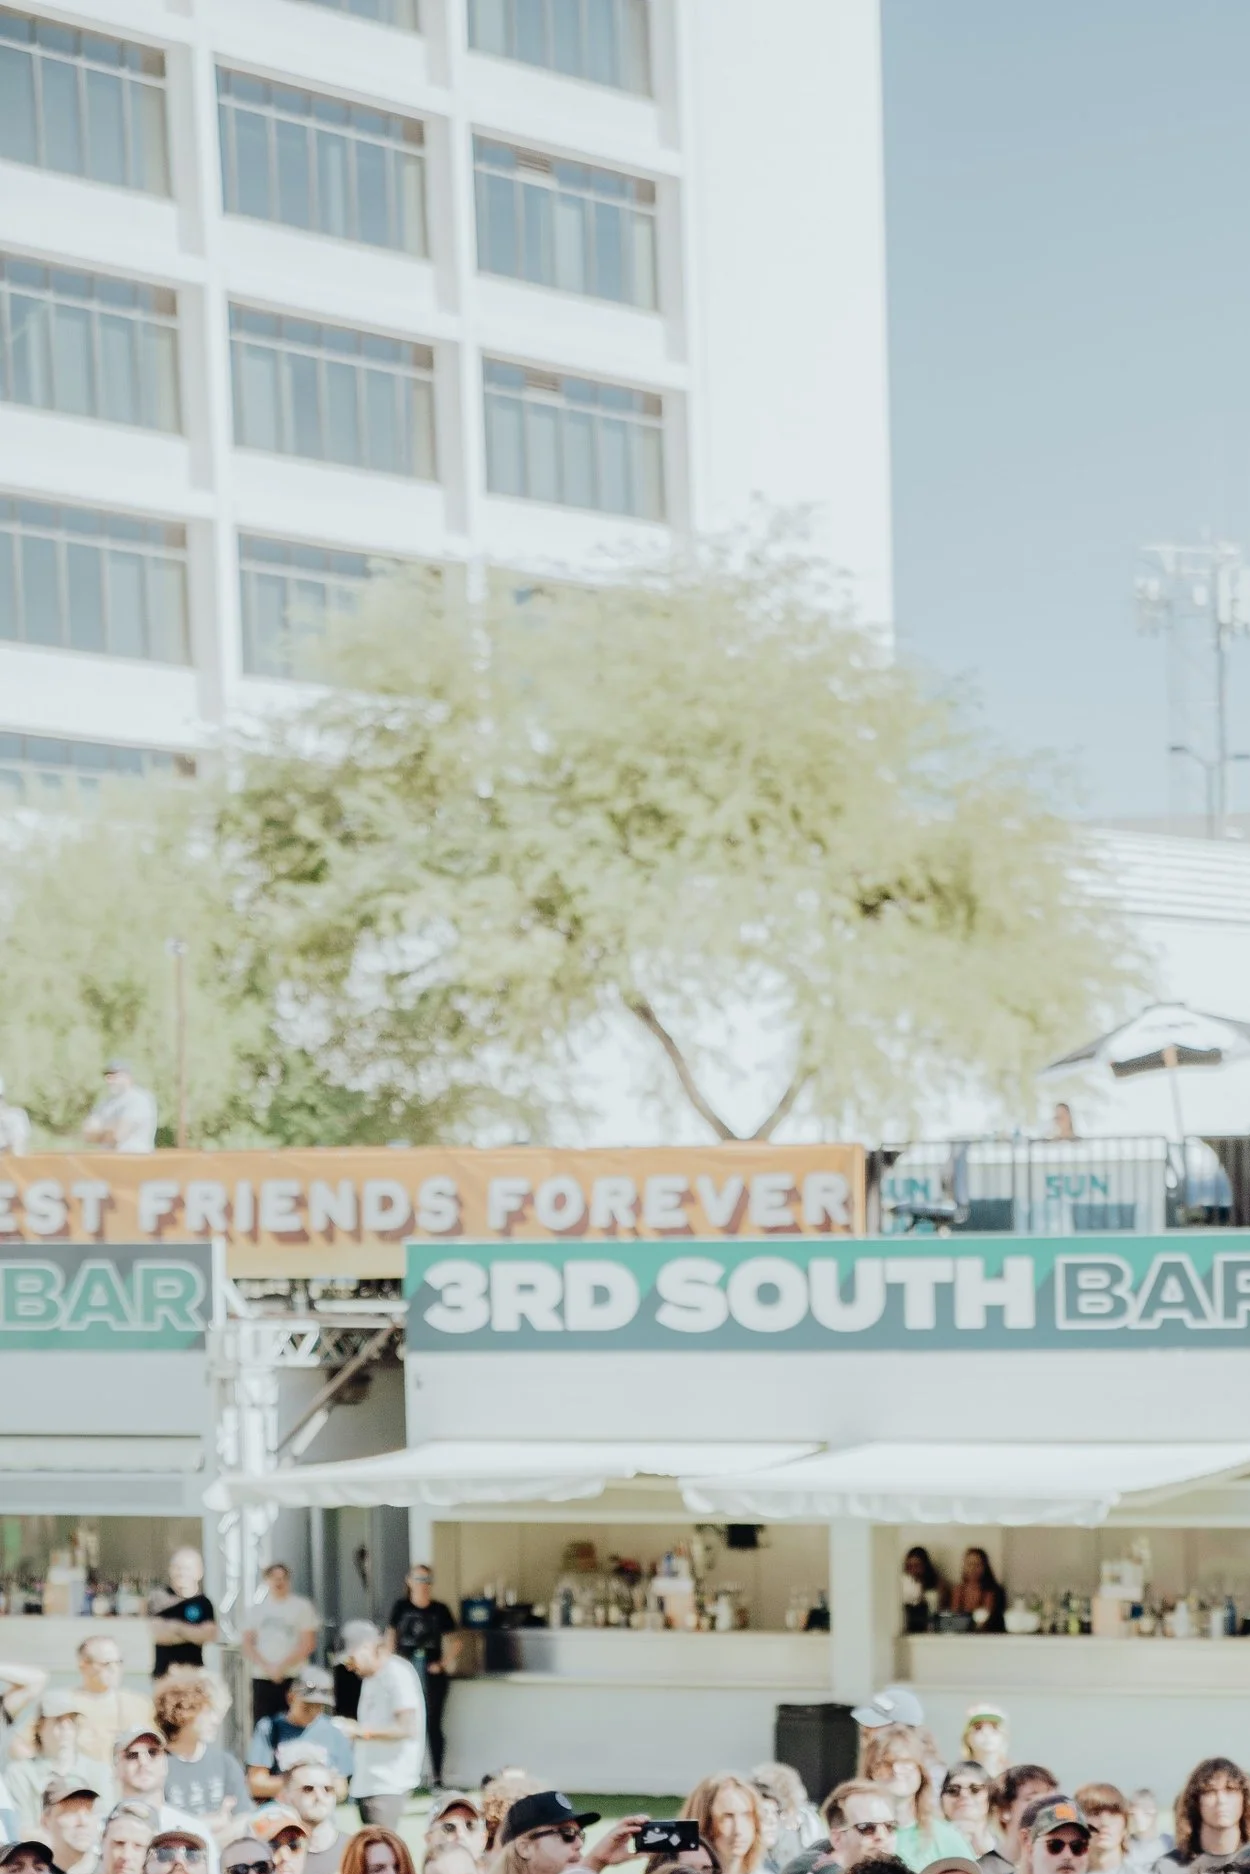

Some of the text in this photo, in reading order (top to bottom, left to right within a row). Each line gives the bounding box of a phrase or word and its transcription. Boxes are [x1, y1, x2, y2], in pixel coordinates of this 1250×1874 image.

[138, 1175, 460, 1234] FRIENDS
[486, 1172, 851, 1231] FOREVER
[1045, 1174, 1110, 1200] SUN
[0, 1258, 208, 1333] BAR
[424, 1258, 641, 1334] 3RD
[654, 1256, 1036, 1334] SOUTH
